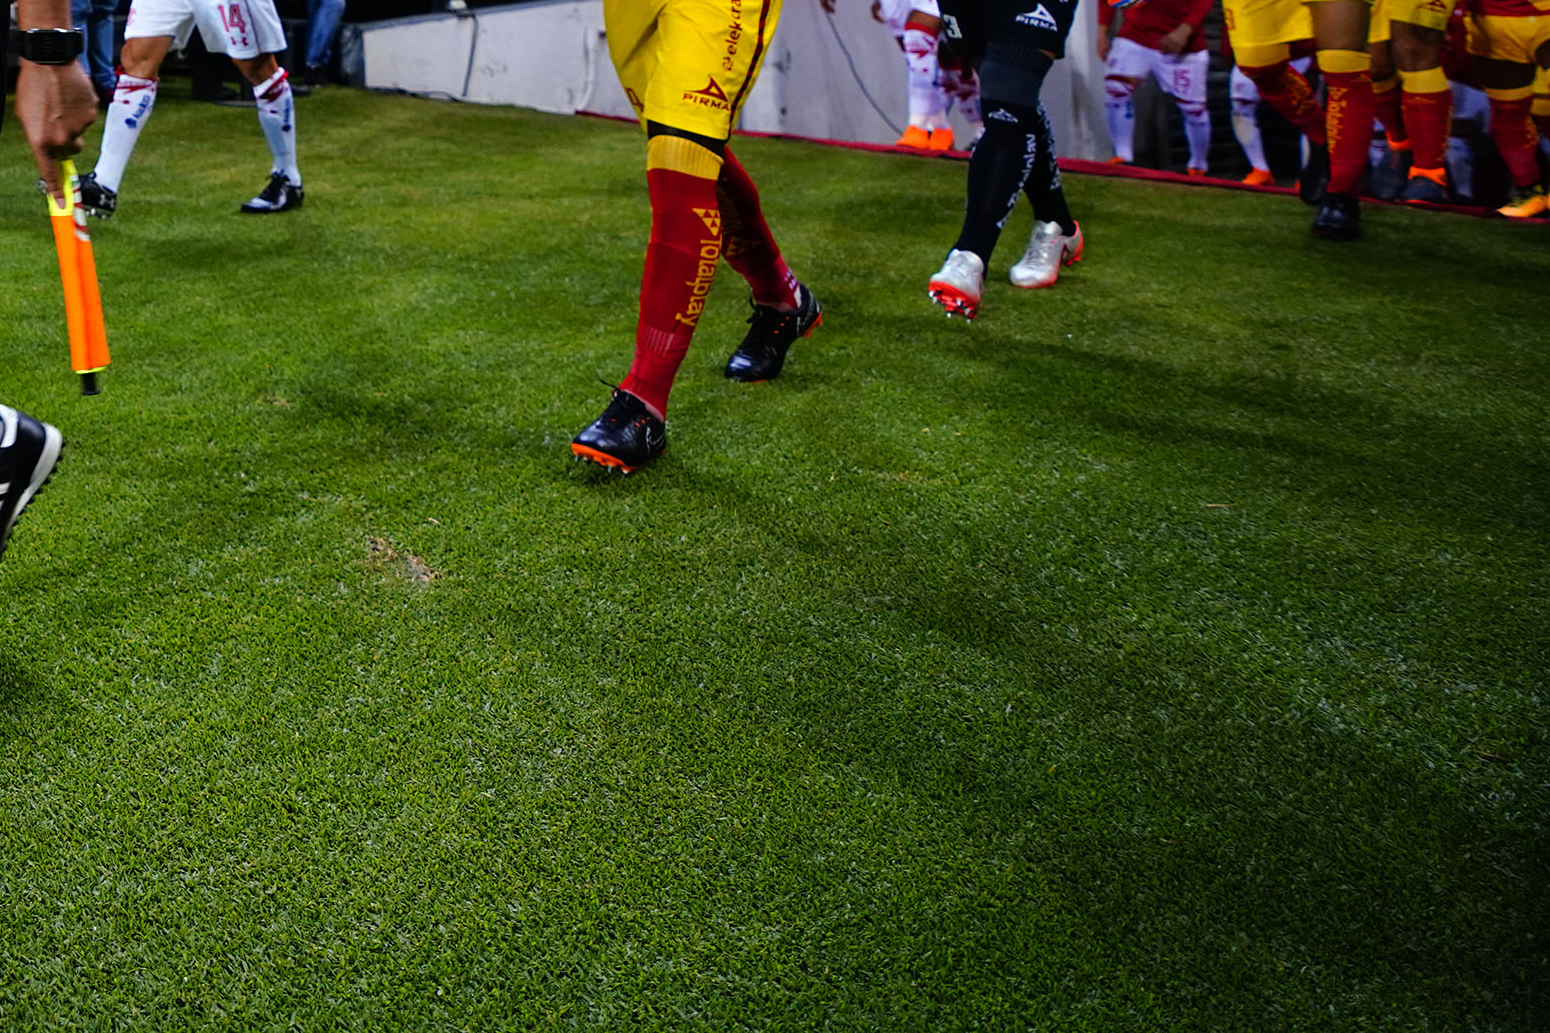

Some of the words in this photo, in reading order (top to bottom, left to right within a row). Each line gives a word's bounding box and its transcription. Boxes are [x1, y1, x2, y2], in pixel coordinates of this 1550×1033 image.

[217, 3, 247, 35] 14
[1173, 69, 1191, 87] 15
[682, 92, 730, 112] PIRMA
